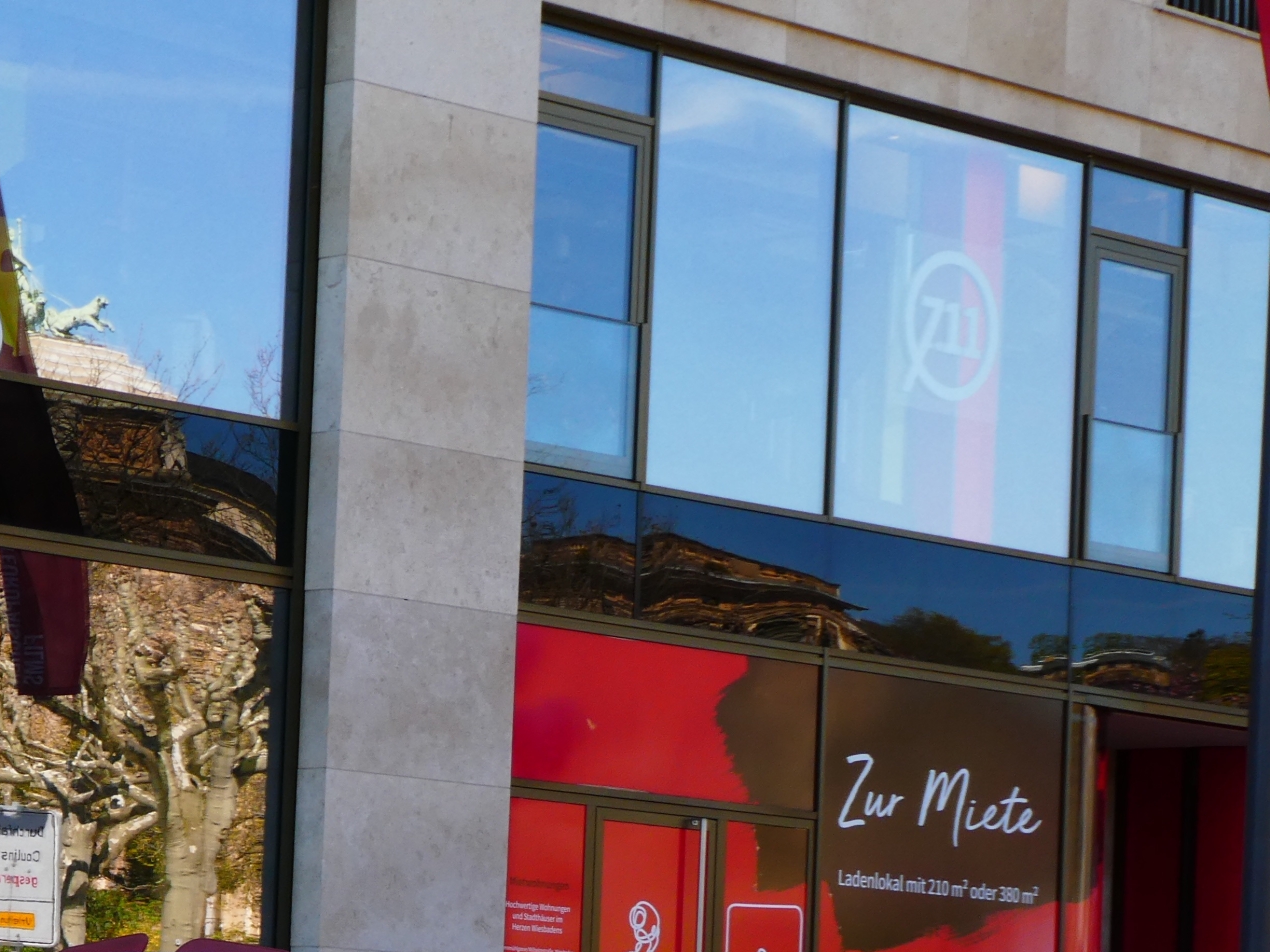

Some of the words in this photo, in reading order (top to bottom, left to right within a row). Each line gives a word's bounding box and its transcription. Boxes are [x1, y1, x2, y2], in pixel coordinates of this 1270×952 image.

[838, 753, 905, 828] Zur
[917, 768, 1043, 847] Miete
[838, 869, 904, 892] Ladenlokal
[906, 877, 926, 894] mit
[928, 879, 949, 896] 210
[970, 883, 998, 900] oder
[998, 886, 1020, 903] 380
[539, 903, 571, 914] Wohnungen
[512, 912, 523, 920] und
[512, 923, 530, 931] Herzen
[531, 925, 563, 934] Wiesbadens
